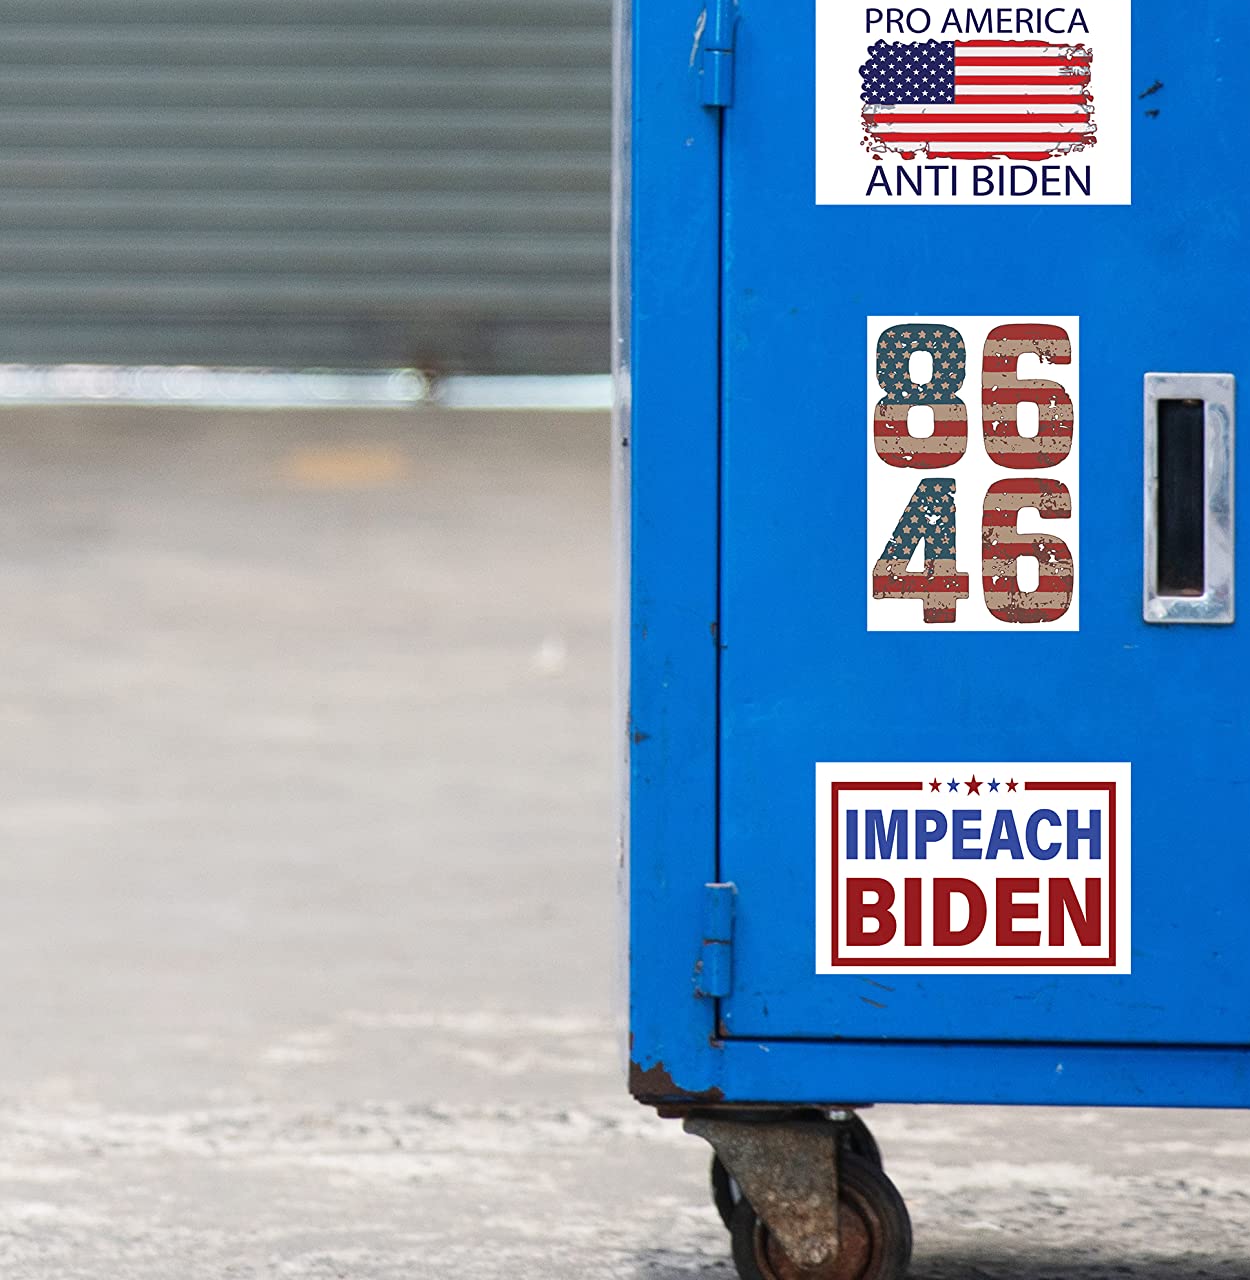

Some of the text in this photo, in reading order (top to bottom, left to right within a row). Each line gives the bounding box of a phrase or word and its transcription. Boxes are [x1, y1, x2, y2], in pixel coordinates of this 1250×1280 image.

[865, 8, 1090, 34] PRO AMERICA
[865, 165, 1091, 197] ANTI BIDEN
[873, 323, 1074, 470] 86
[872, 477, 1075, 624] 46
[846, 808, 1101, 861] IMPEACH
[846, 877, 1101, 947] BIDEN
